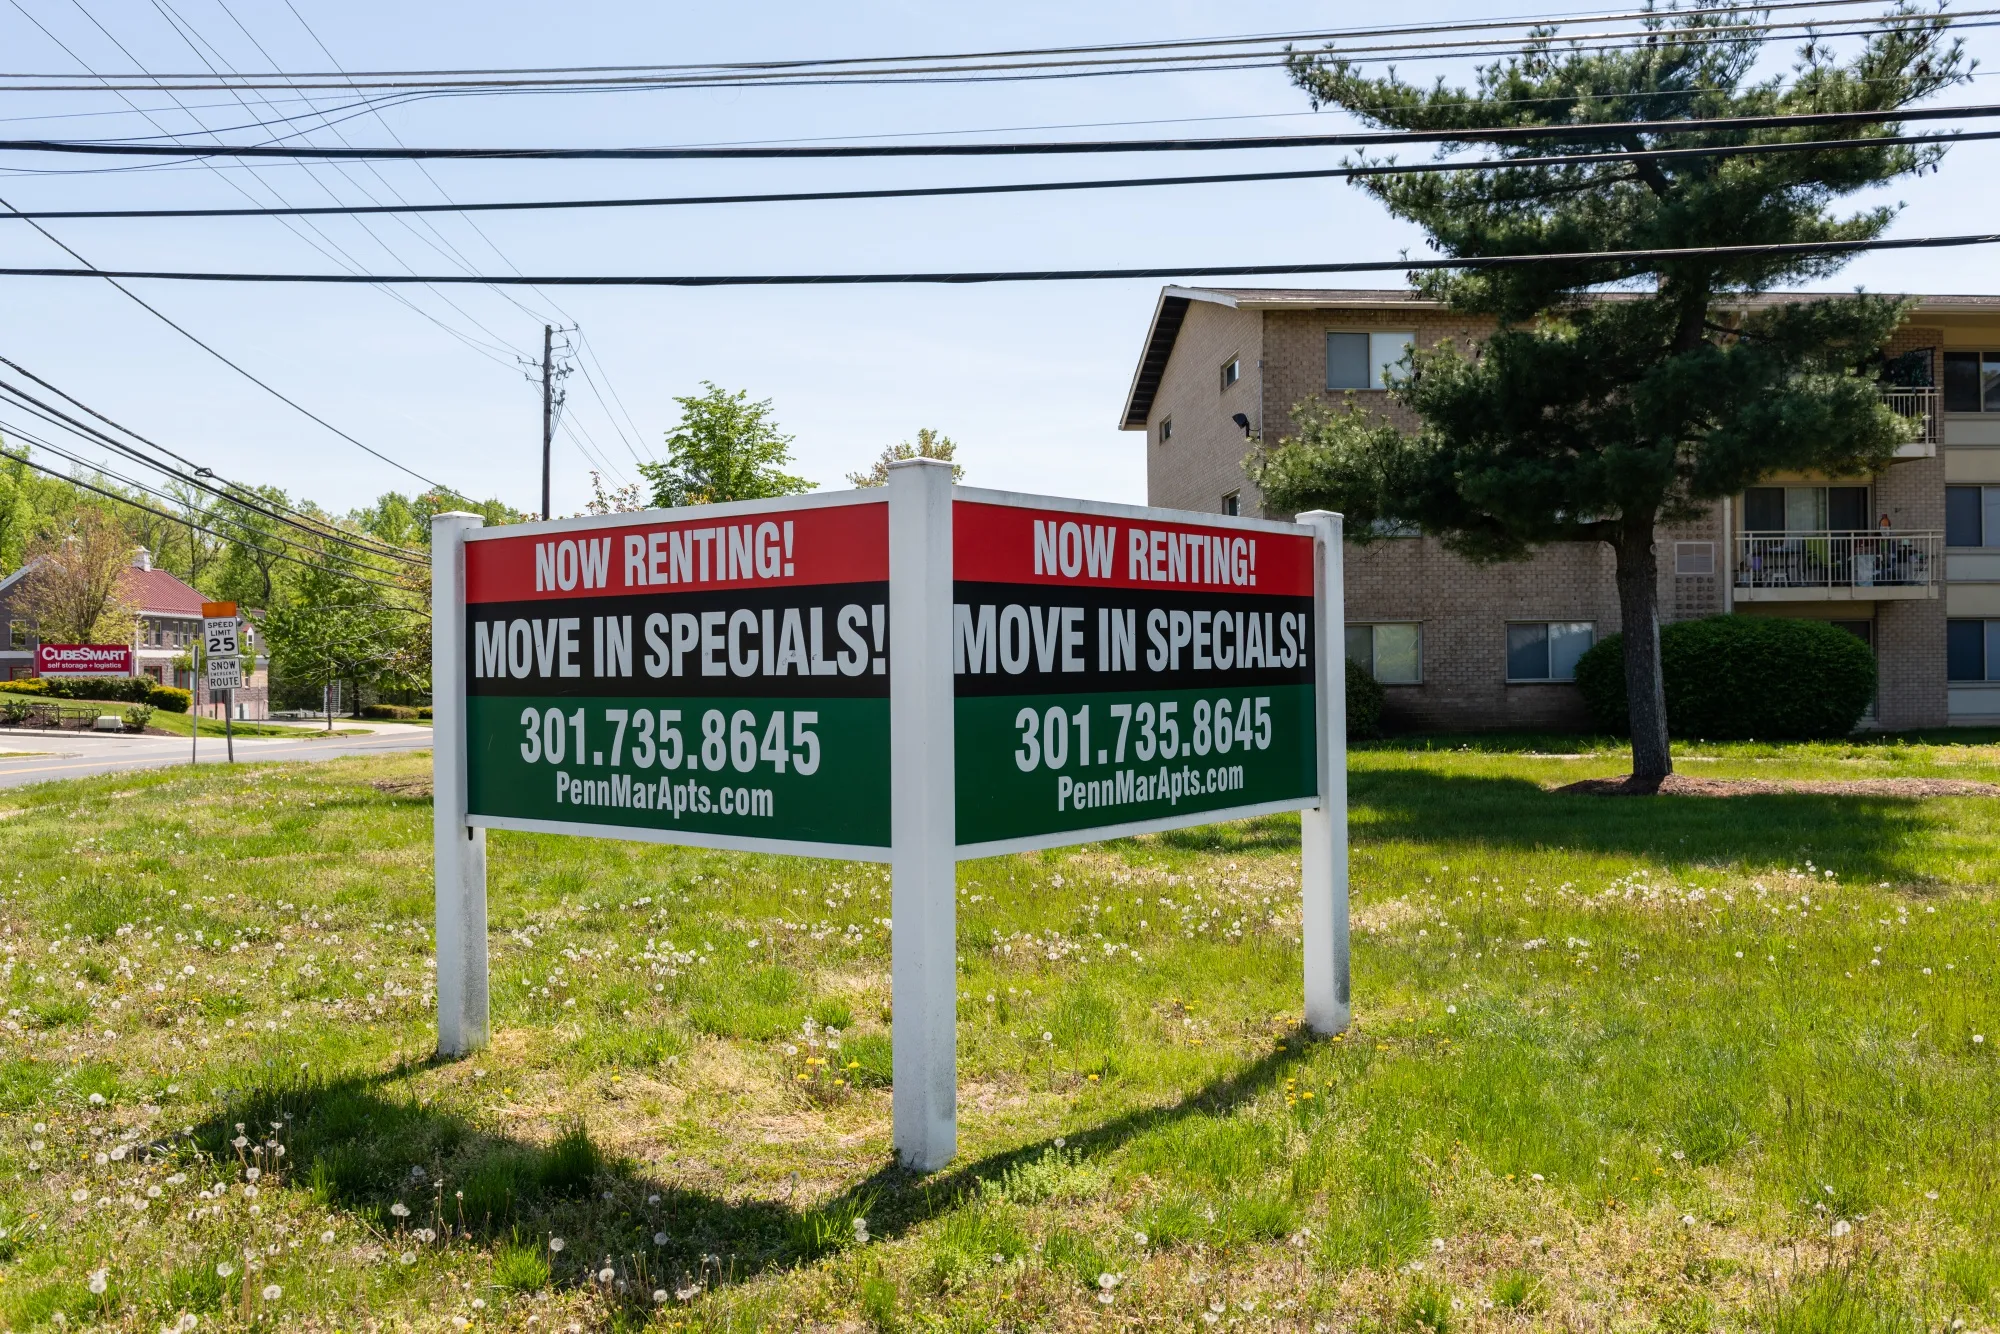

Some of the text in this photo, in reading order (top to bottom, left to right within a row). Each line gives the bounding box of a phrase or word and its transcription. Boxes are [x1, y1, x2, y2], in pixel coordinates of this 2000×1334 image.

[536, 520, 795, 592] NOW RENTING!
[1033, 519, 1257, 586] NOW RENTING!
[207, 621, 234, 629] SPEED
[209, 637, 236, 652] 25
[210, 629, 231, 637] LIMIT
[474, 604, 887, 679] MOVE IN SPECIALS!
[953, 603, 1307, 675] MOVE IN SPECIALS!
[61, 662, 88, 670] storage
[94, 662, 122, 670] logistics
[210, 676, 239, 687] ROUTE
[211, 661, 236, 671] SNOW
[520, 706, 821, 776] 301.735.8645
[1014, 696, 1272, 773] 301.735.8645
[556, 770, 774, 819] PennMarApts.com
[1057, 764, 1244, 812] PennMarApts.com
